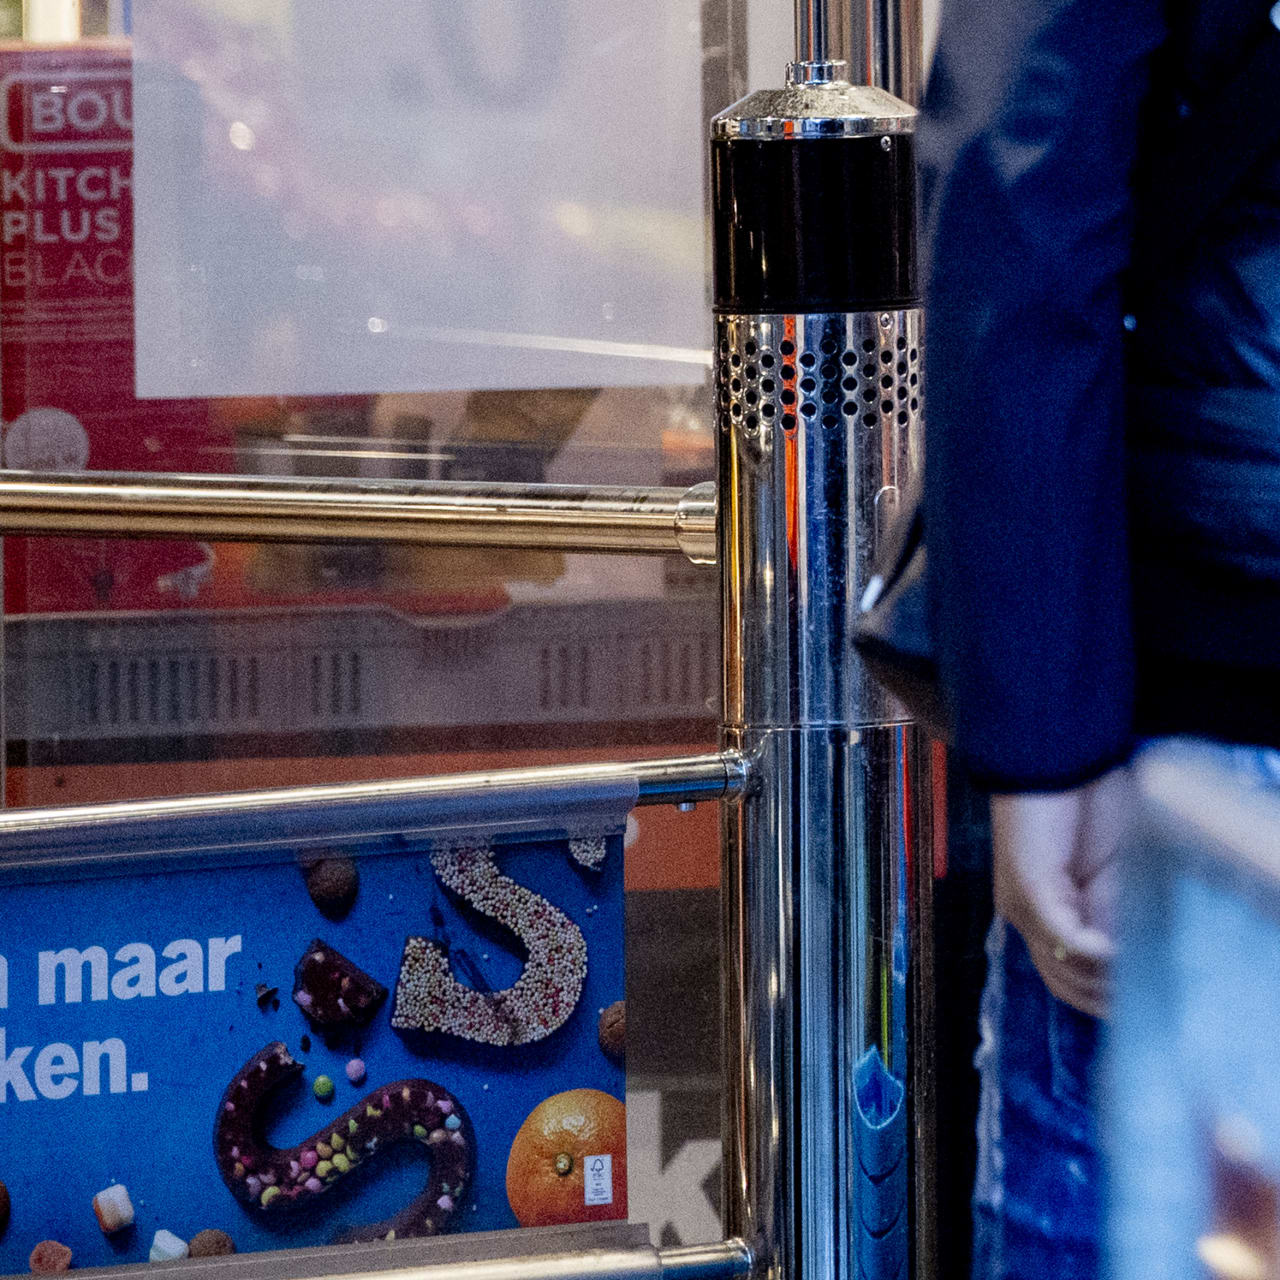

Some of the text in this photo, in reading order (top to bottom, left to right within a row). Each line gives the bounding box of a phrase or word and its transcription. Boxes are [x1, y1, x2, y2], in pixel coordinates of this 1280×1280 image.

[31, 90, 132, 133] BOU
[3, 167, 132, 202] KITCH
[3, 208, 120, 244] PLUS
[4, 248, 132, 287] BLAC
[38, 935, 242, 1005] maar
[0, 1027, 148, 1103] ken.
